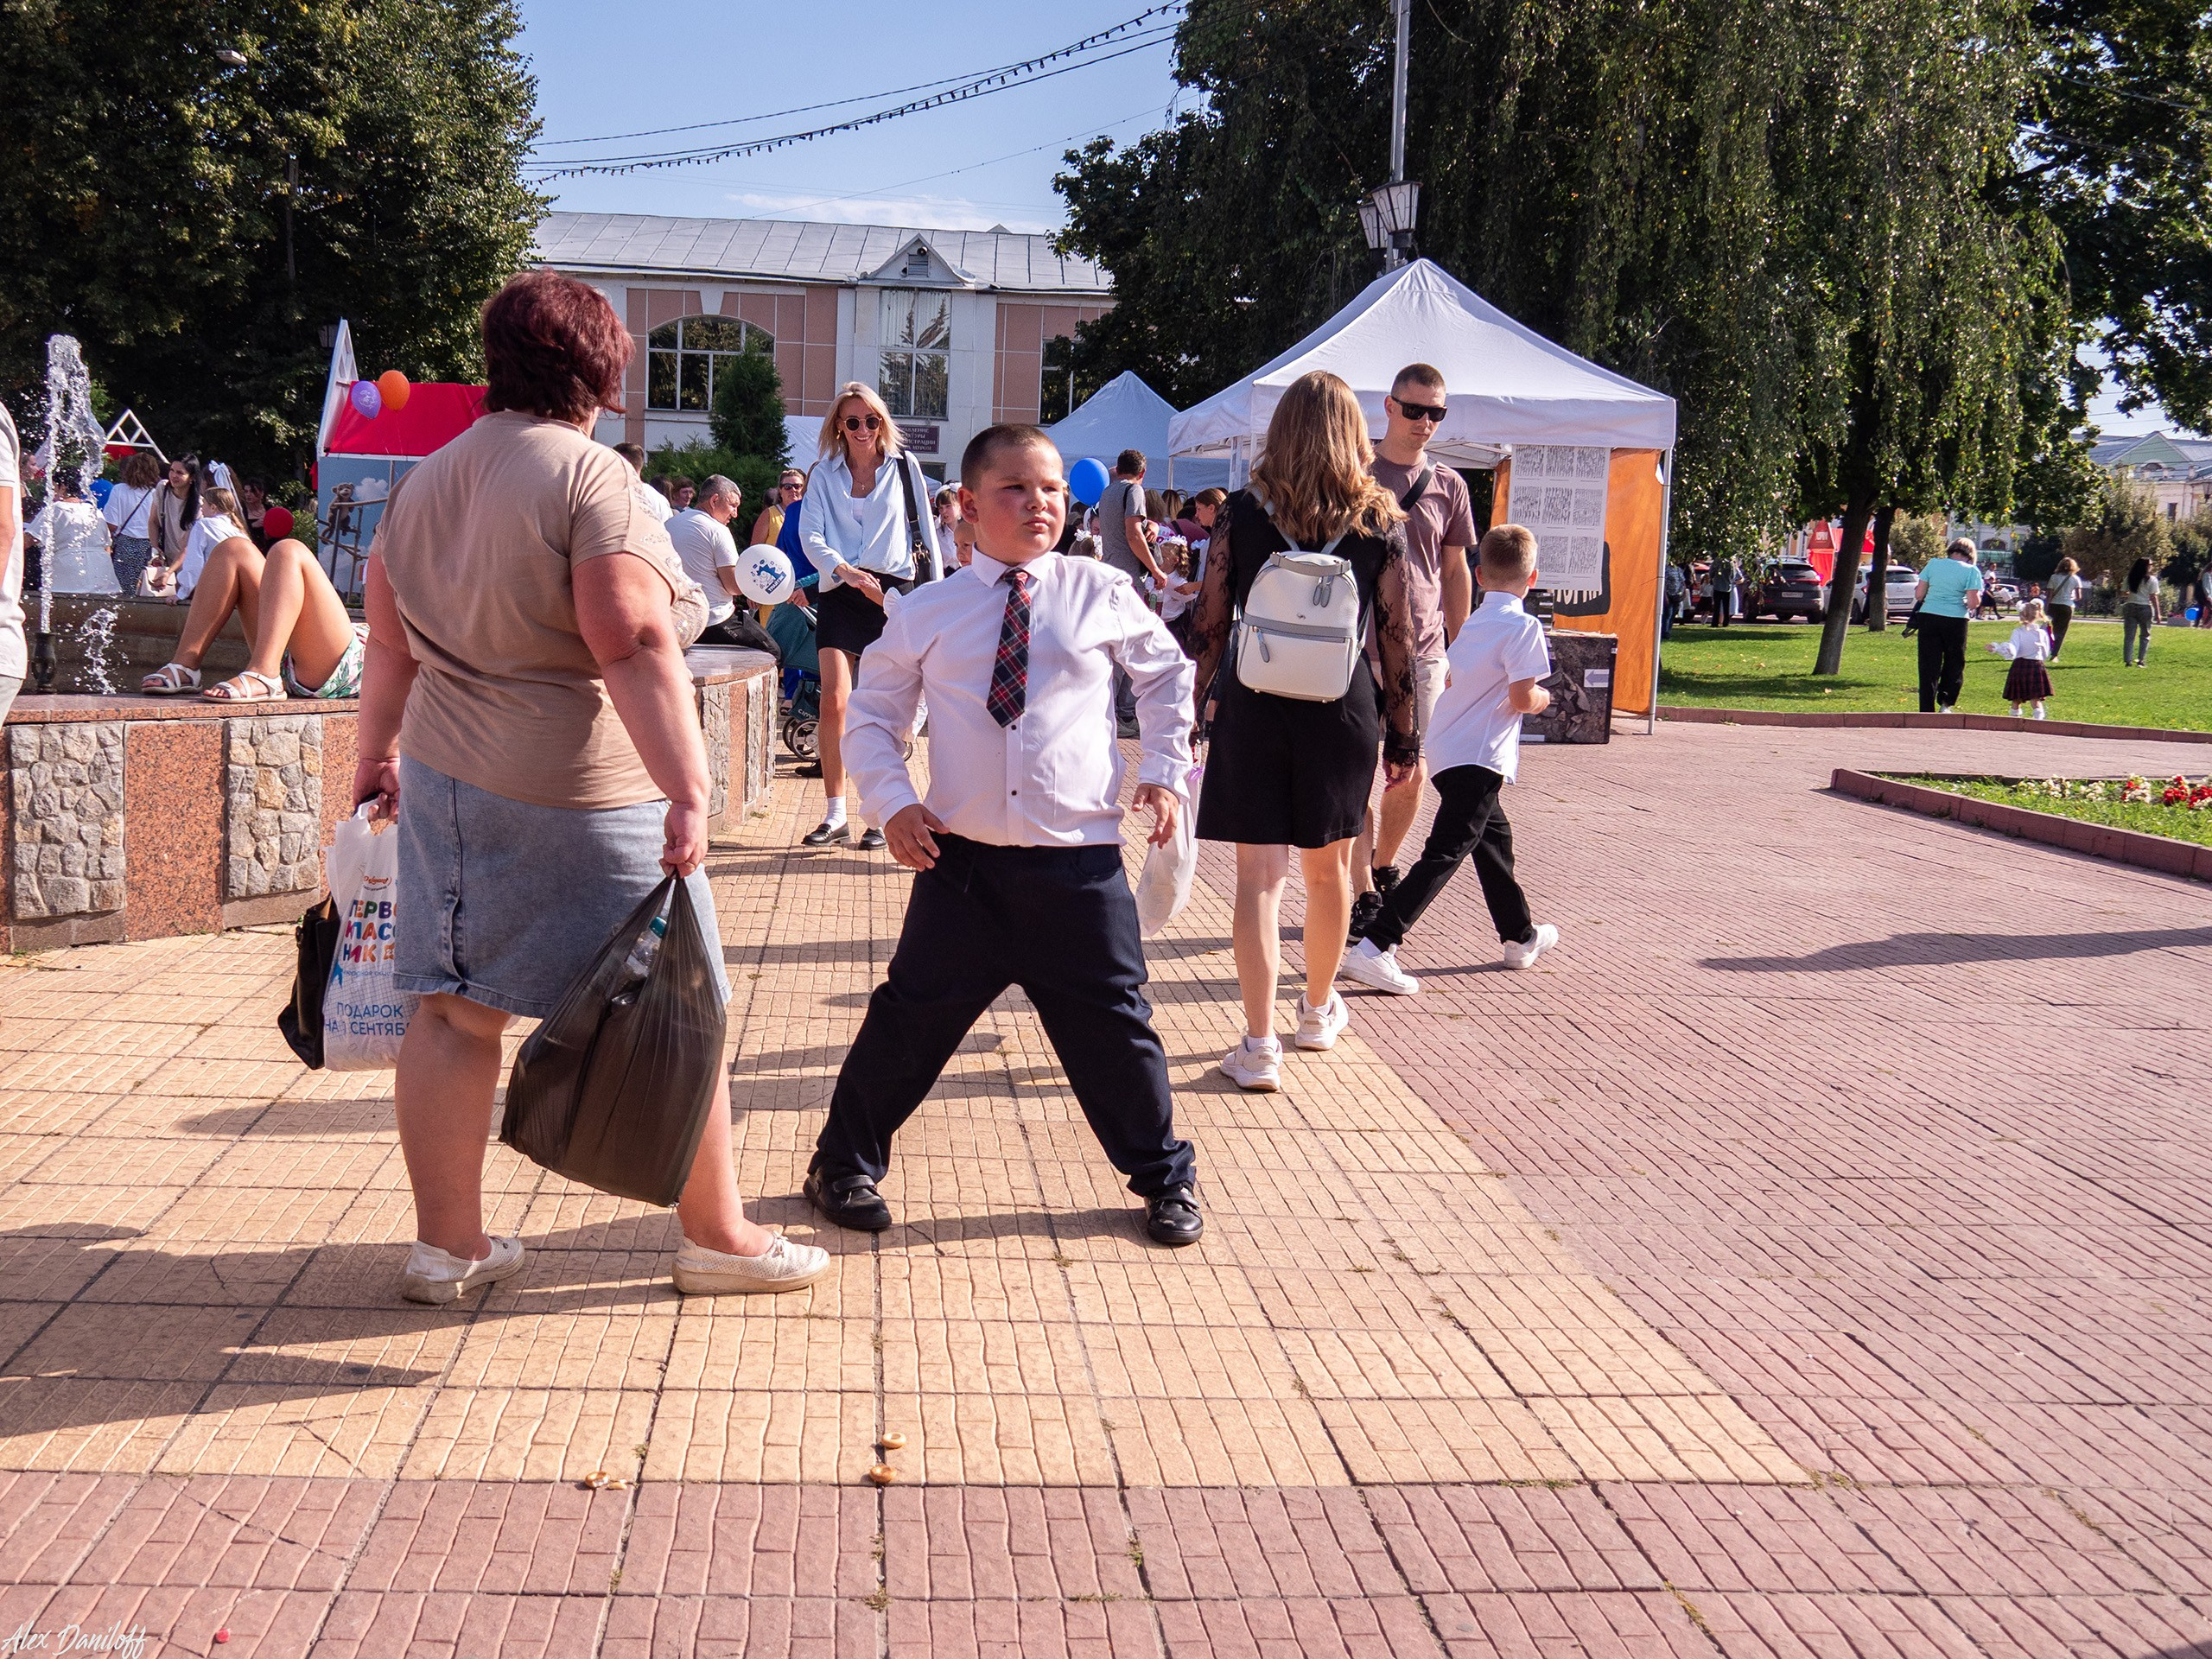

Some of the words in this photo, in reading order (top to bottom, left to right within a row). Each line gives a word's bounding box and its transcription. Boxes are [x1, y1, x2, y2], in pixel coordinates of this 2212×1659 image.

[345, 920, 397, 941] КЛАС
[343, 944, 377, 963] НИК
[337, 1002, 404, 1020] ПОДАРОК
[325, 1018, 339, 1033] НА
[350, 1021, 410, 1036] СЕНТЯБ
